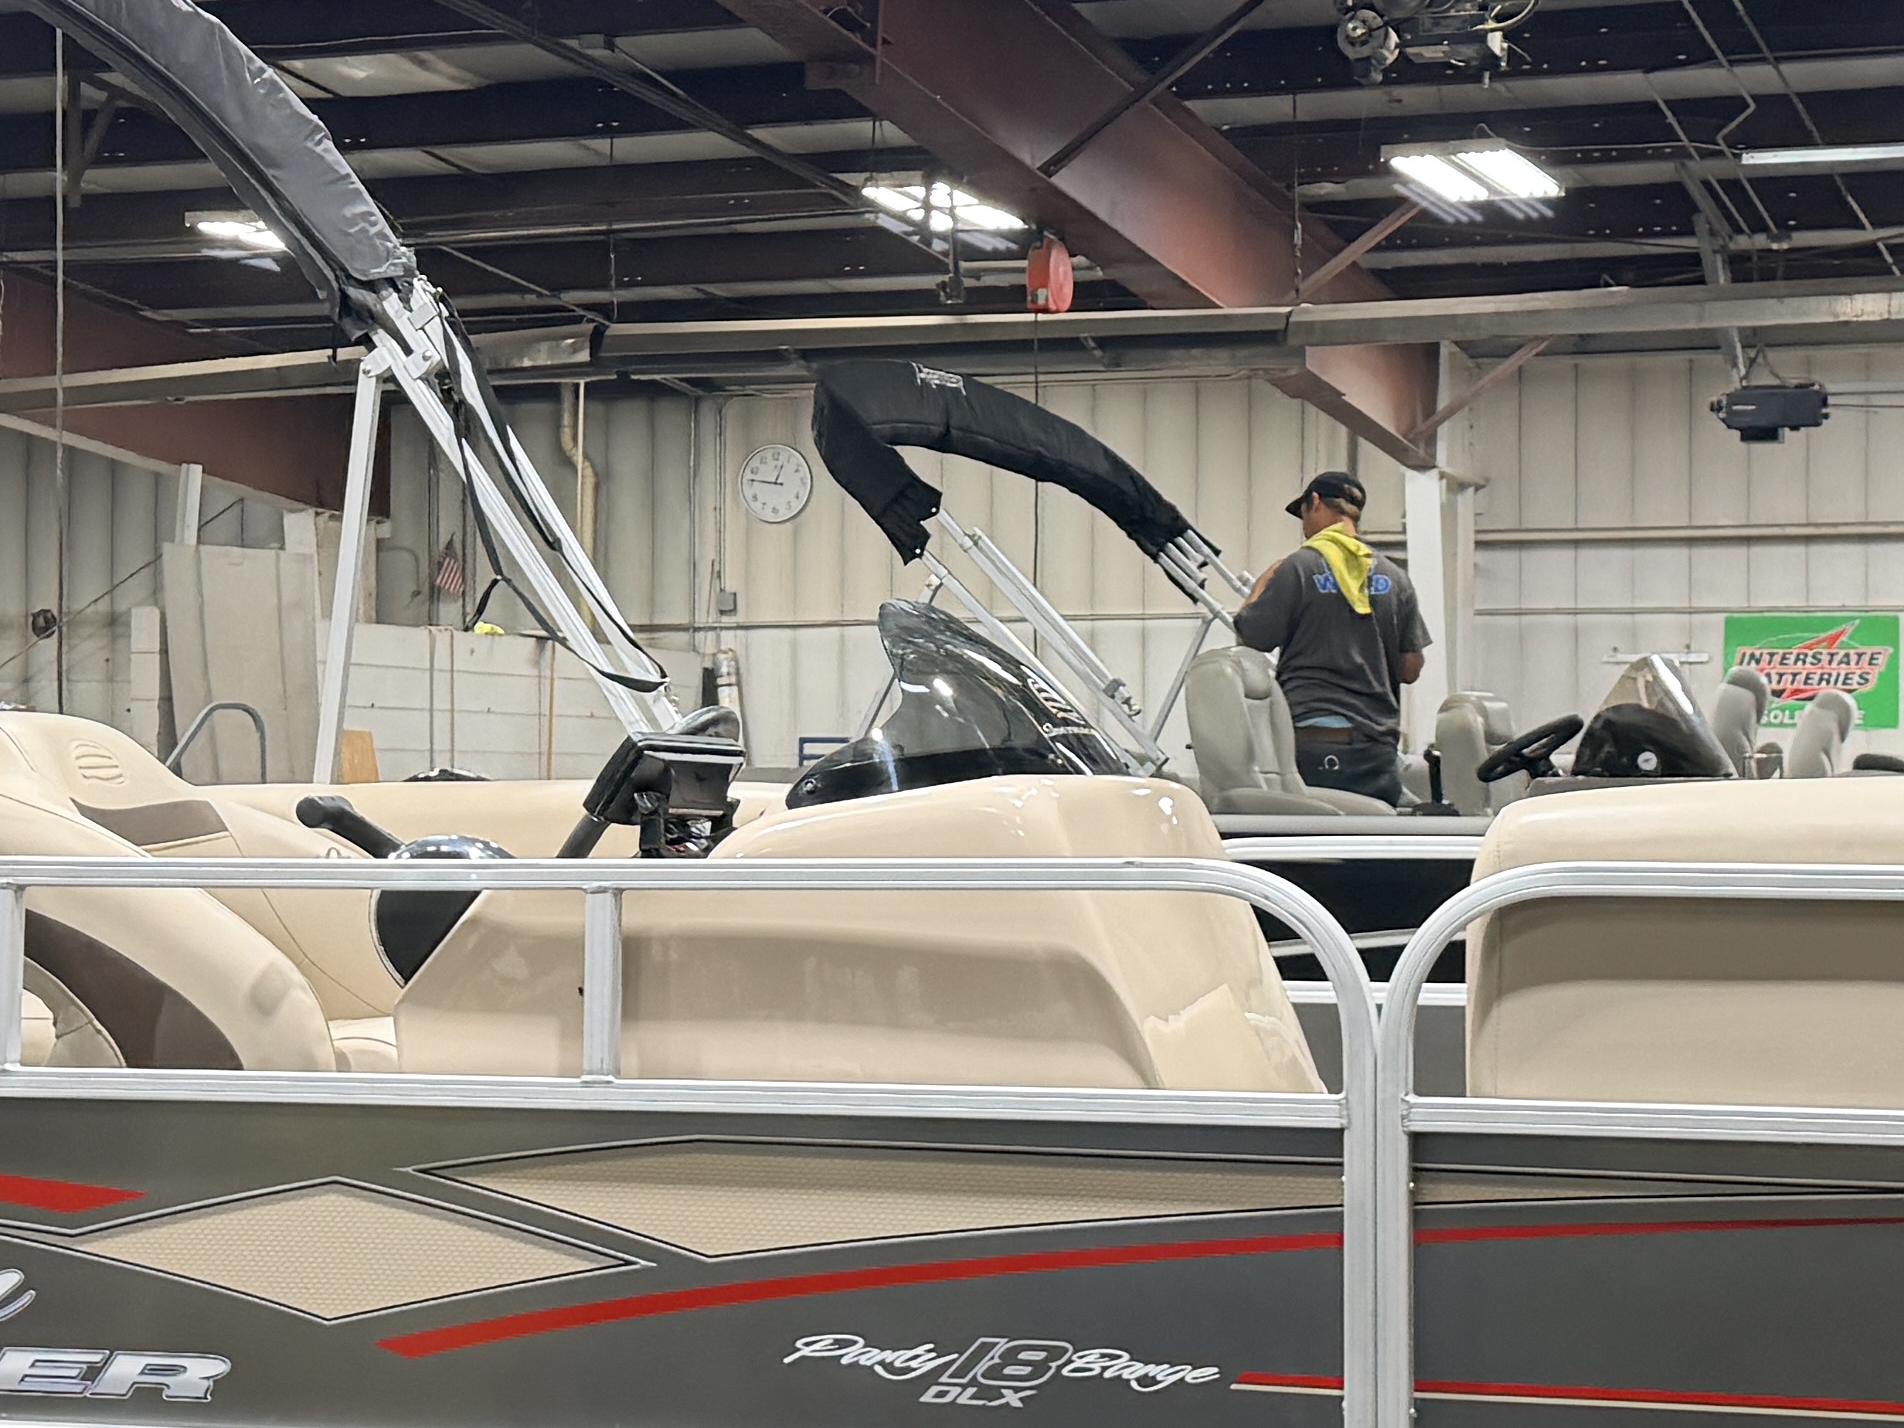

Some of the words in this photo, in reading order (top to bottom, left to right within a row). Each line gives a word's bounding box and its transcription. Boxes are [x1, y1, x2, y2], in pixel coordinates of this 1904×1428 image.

[1739, 651, 1882, 666] INTERSTATE
[1765, 671, 1871, 686] ATTERIES
[782, 1334, 958, 1380] Party
[938, 1337, 1074, 1387] 18
[1060, 1348, 1220, 1392] Barge
[918, 1384, 1038, 1409] DLX
